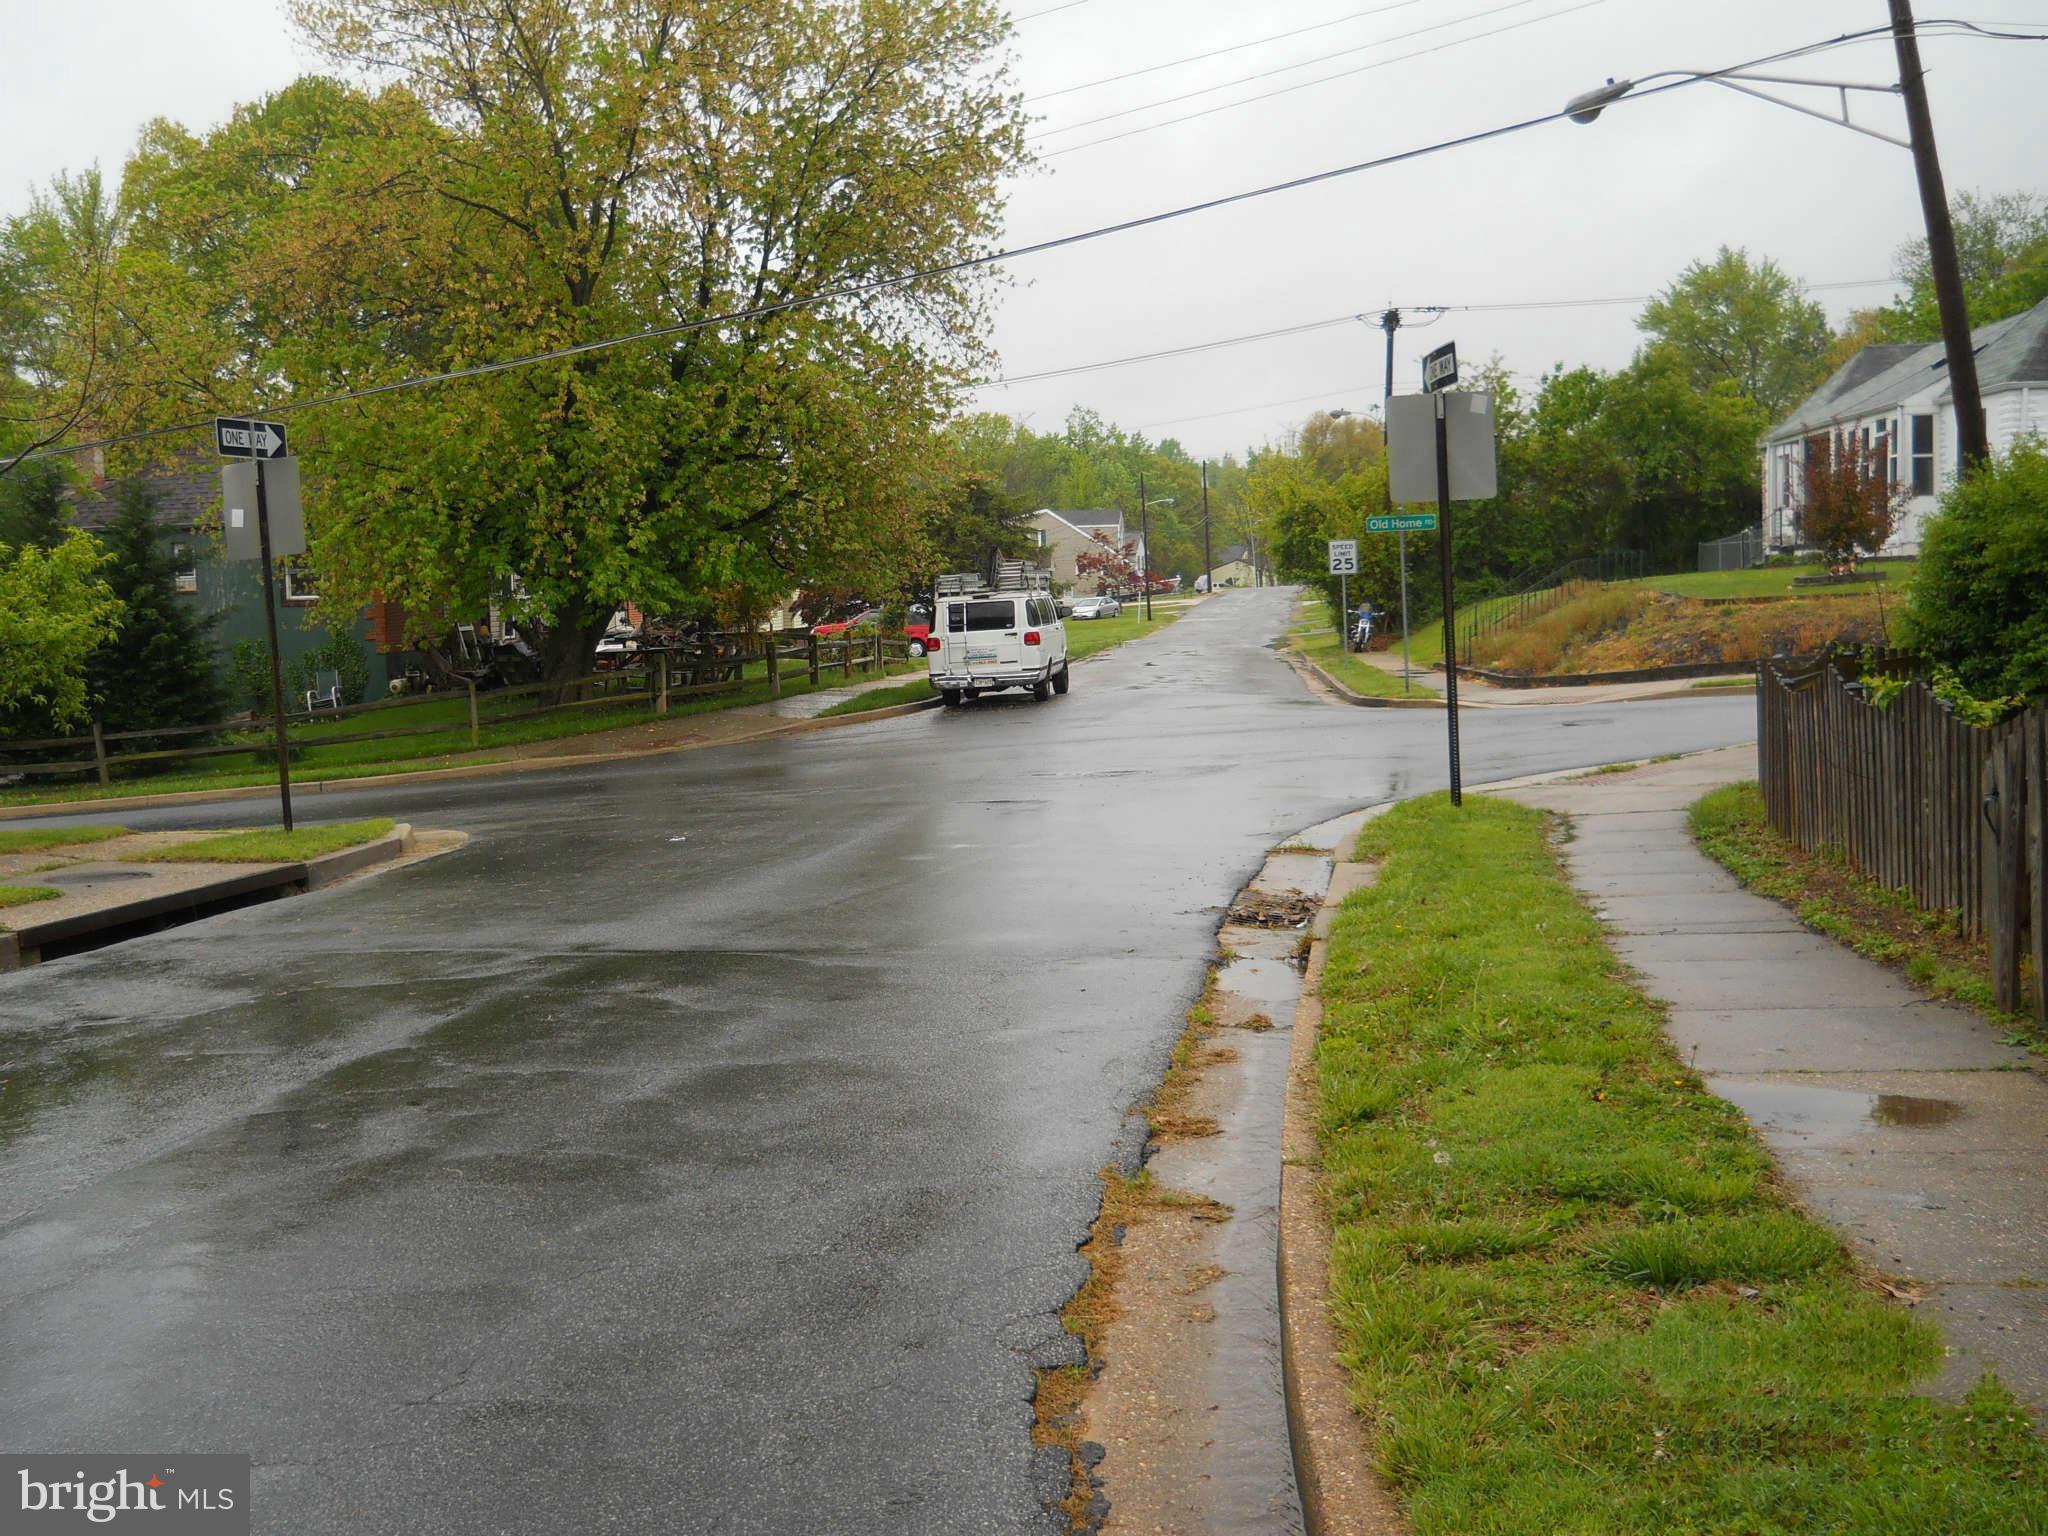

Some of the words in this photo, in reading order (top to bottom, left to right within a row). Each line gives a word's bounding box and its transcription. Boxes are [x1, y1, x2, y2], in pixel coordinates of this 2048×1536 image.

[225, 430, 245, 446] ONE
[1369, 519, 1389, 530] Old
[1391, 518, 1423, 529] Home
[1332, 558, 1354, 570] 25
